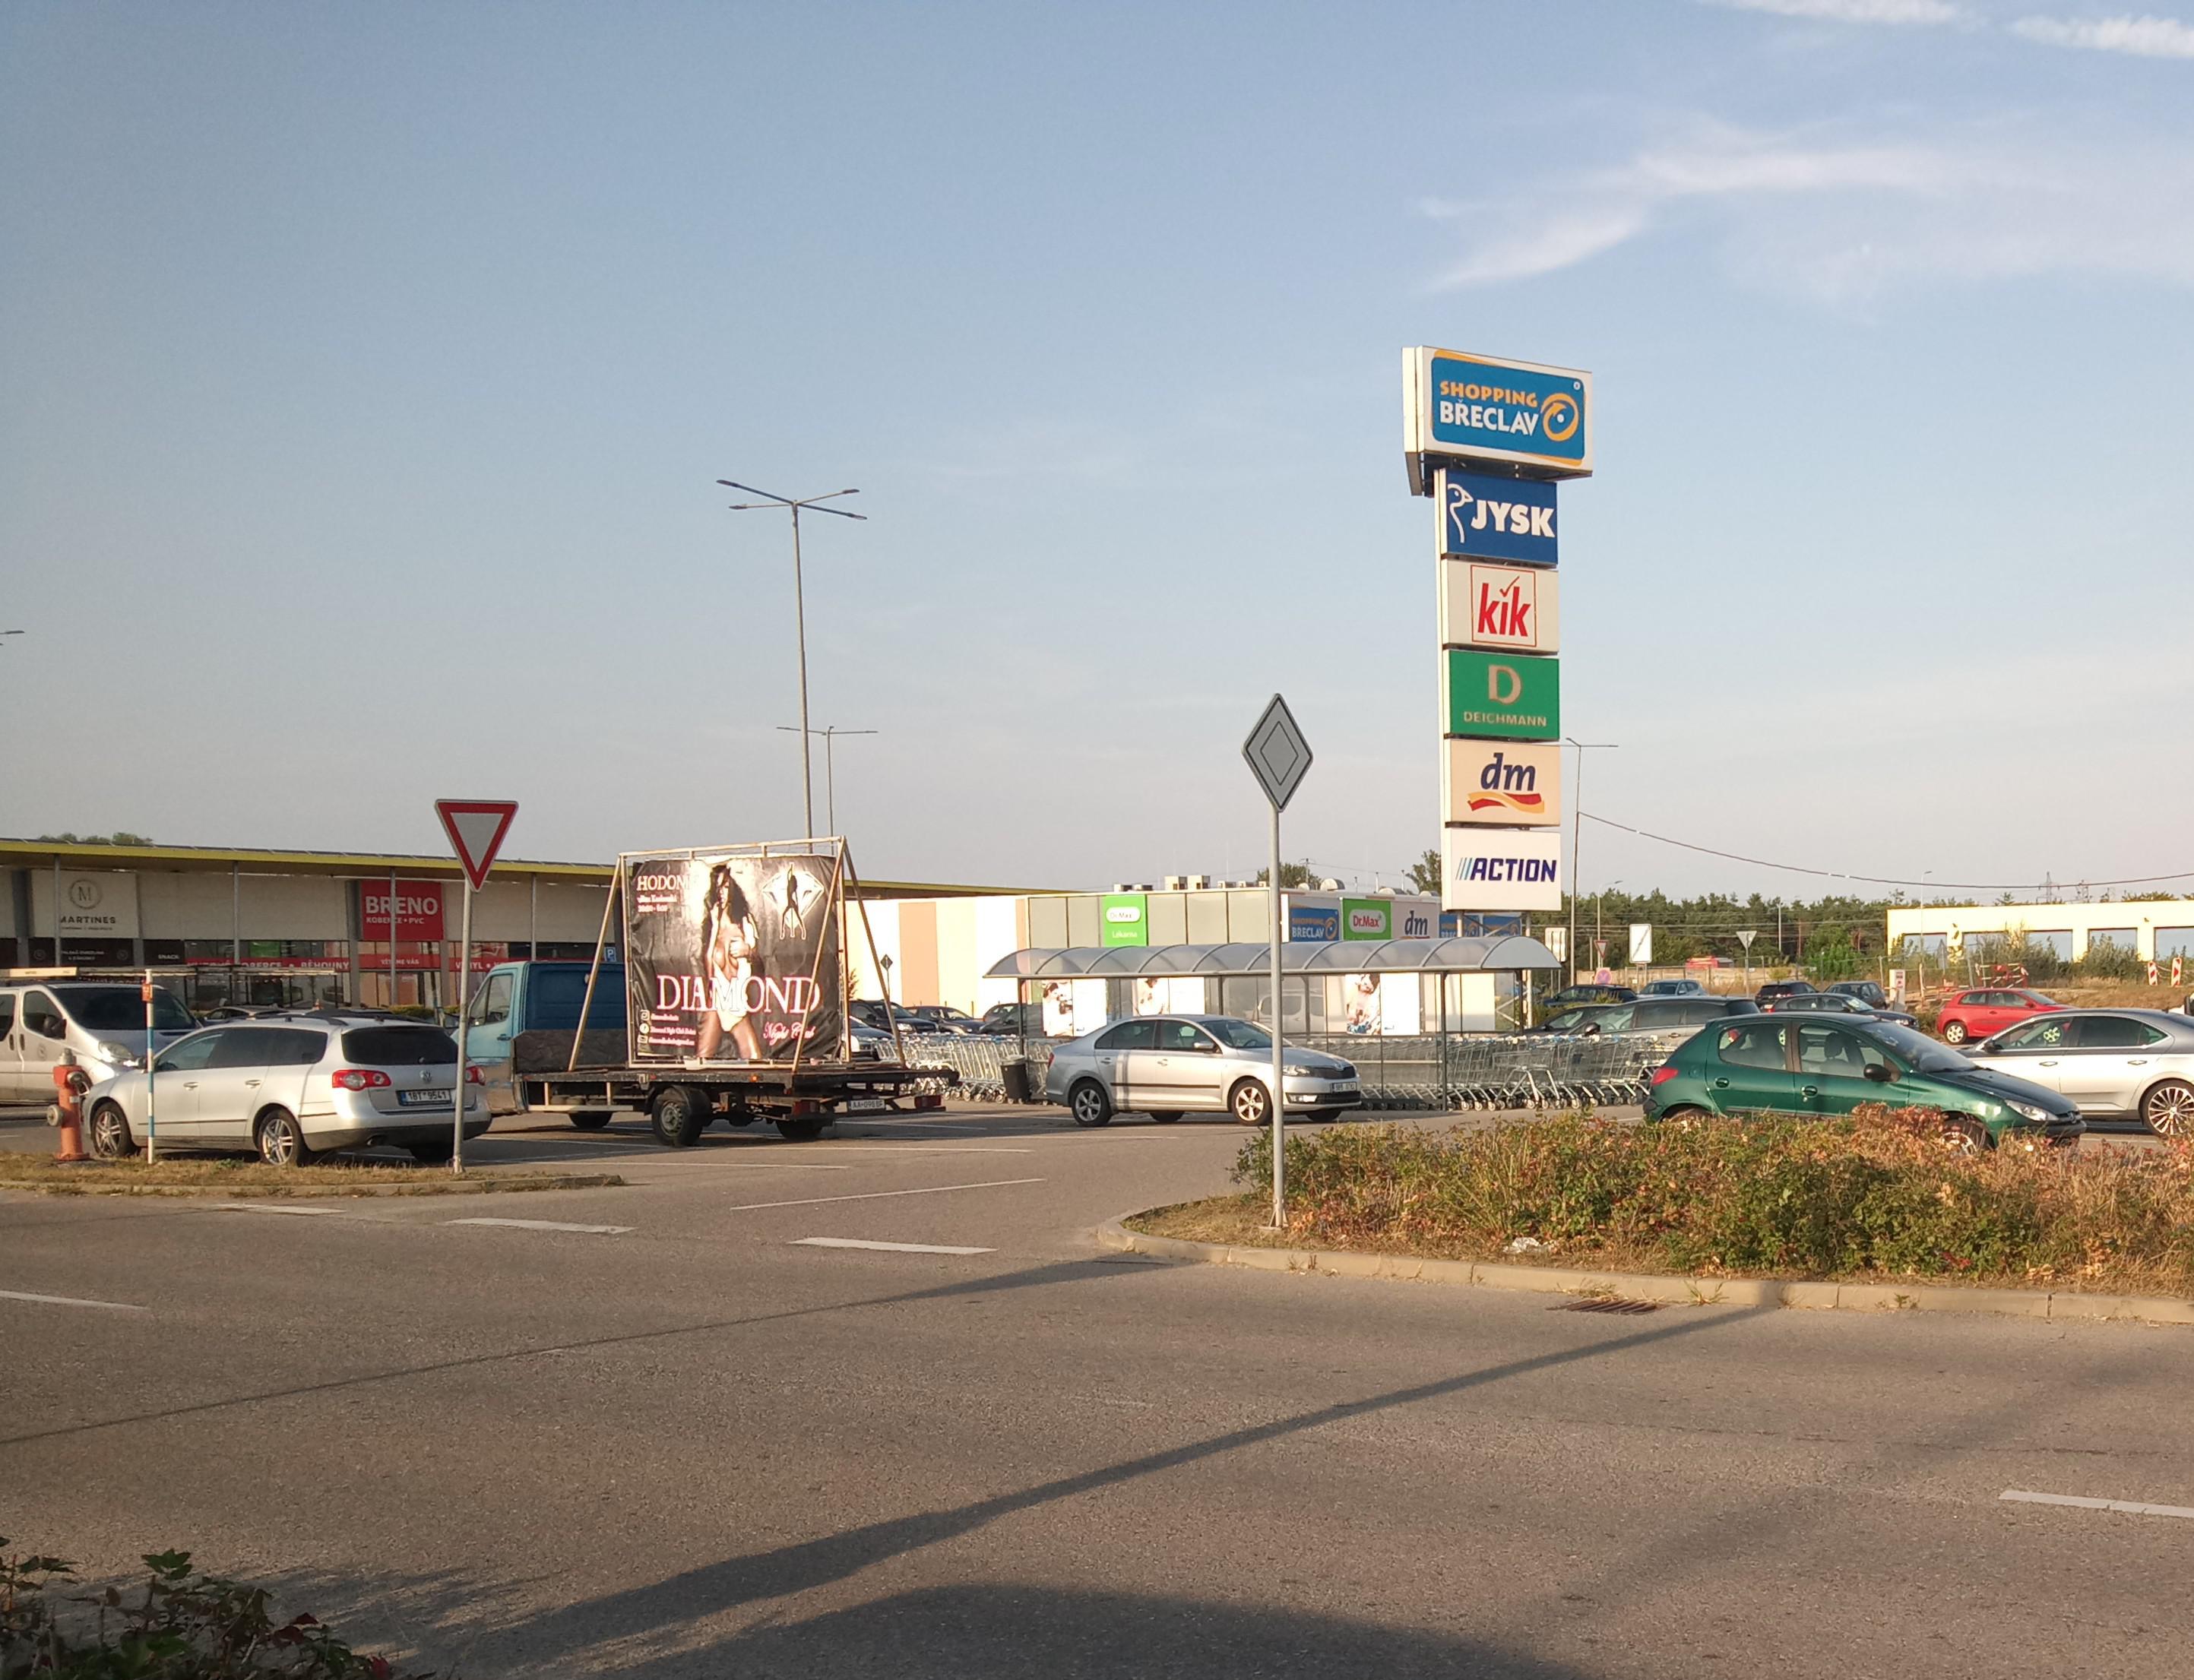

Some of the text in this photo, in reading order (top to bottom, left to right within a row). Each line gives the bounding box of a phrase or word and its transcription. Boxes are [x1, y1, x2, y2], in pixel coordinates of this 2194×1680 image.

[1439, 381, 1538, 407] SHOPPING
[1439, 399, 1539, 437] BŘECLAV
[1471, 498, 1555, 538] JYSK
[1477, 576, 1531, 637] kik
[1487, 664, 1522, 705] D
[1463, 710, 1547, 727] DEICHMANN
[1480, 752, 1536, 792] dm
[1470, 857, 1557, 882] ACTION
[365, 896, 438, 915] BRENO
[1353, 915, 1379, 928] Dr.Max
[1404, 910, 1429, 935] dm
[657, 974, 821, 1014] DIAMOND
